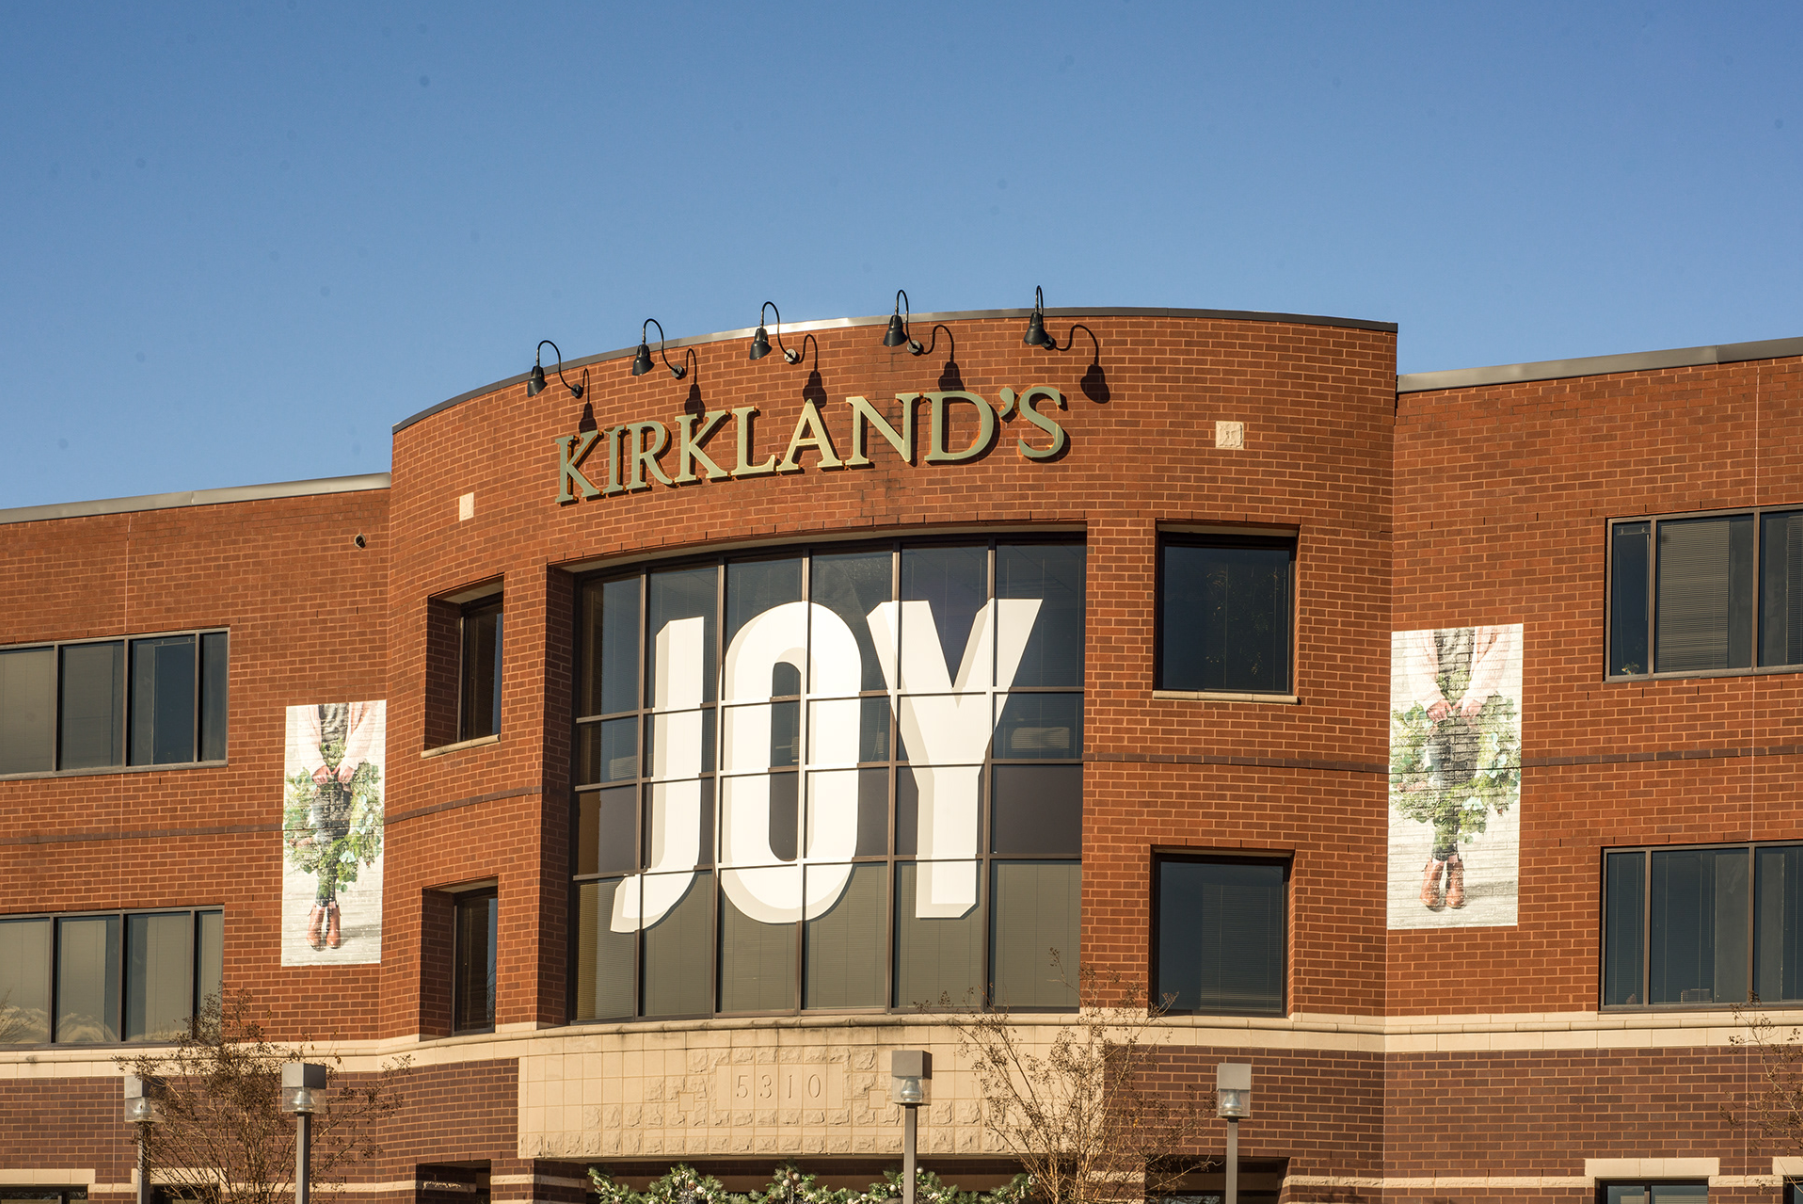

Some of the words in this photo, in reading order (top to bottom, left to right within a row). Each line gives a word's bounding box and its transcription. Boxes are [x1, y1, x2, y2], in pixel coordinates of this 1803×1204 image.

[555, 385, 1068, 503] KIRKLAND'S
[610, 598, 1044, 933] JOY
[736, 1073, 822, 1099] 5310
